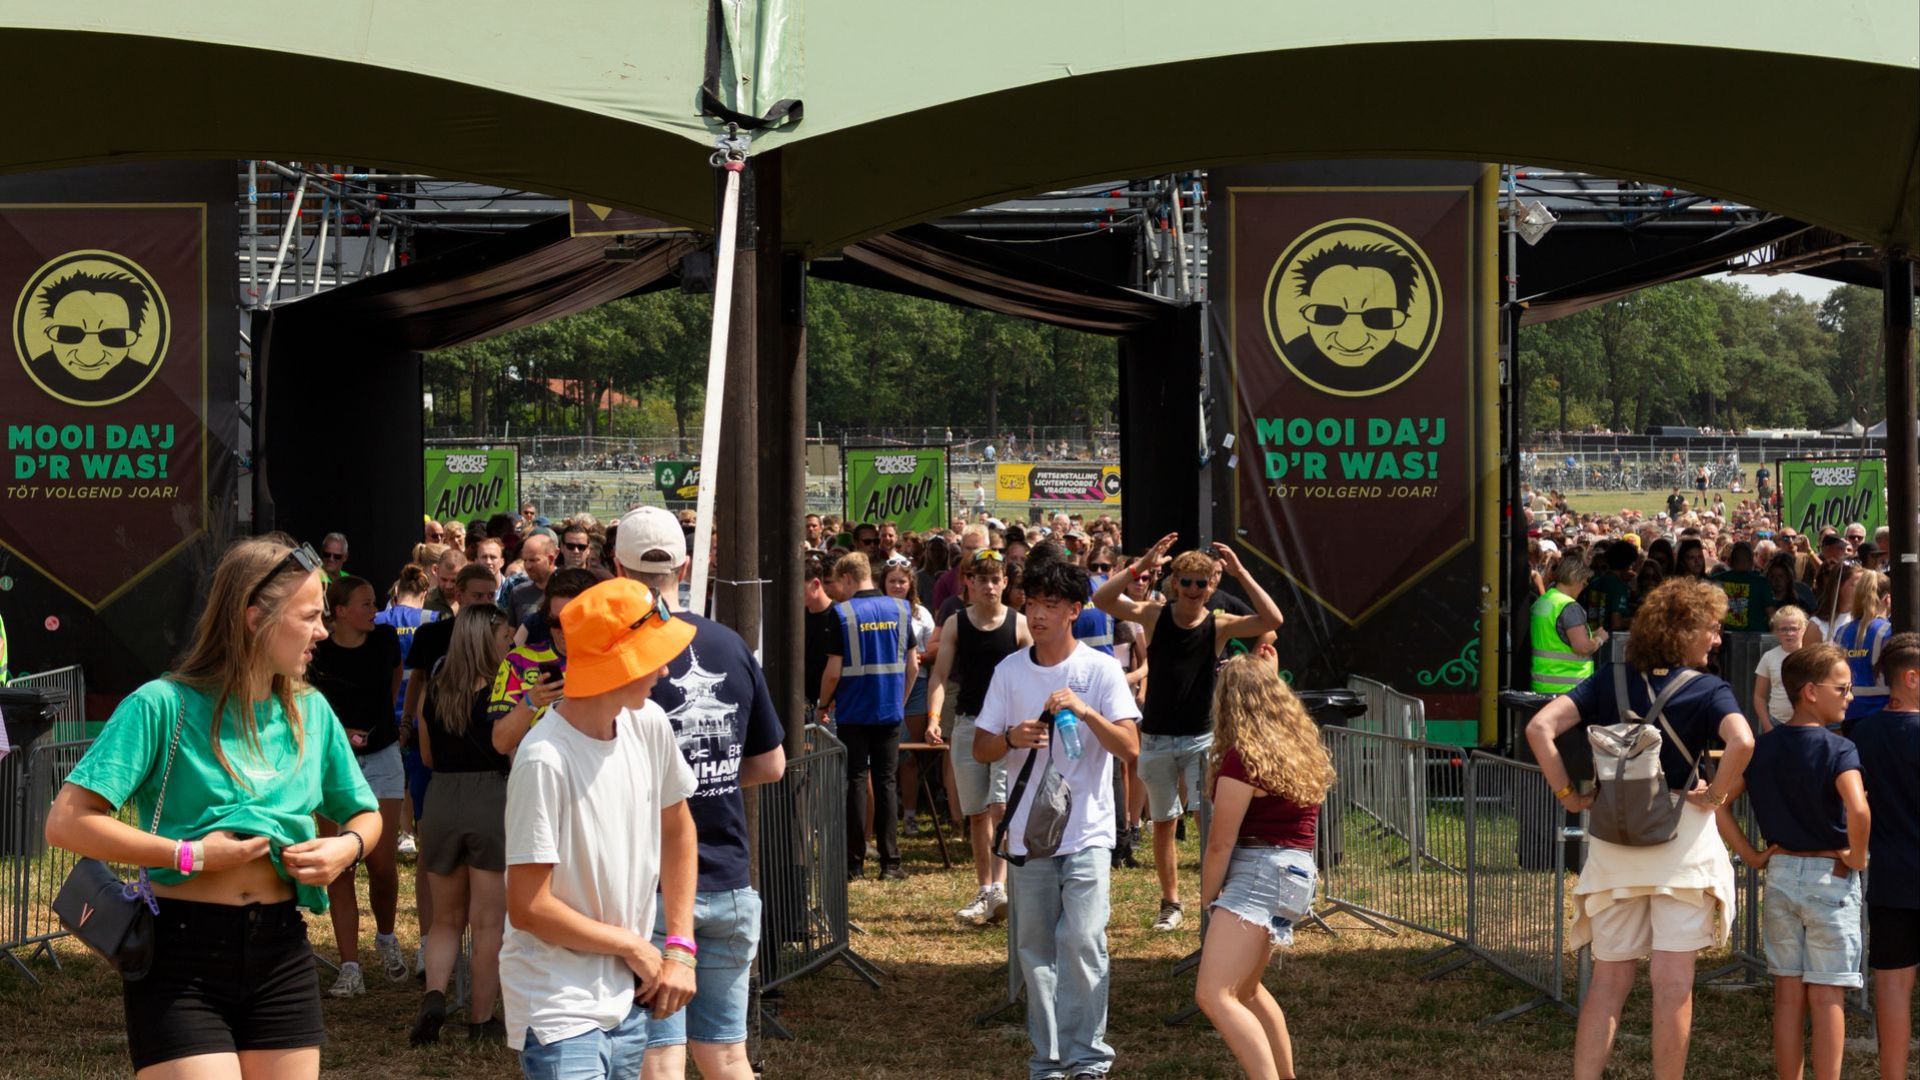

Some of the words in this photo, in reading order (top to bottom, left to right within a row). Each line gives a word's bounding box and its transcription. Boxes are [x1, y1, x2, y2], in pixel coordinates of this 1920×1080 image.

[8, 424, 95, 450] MOOI
[1256, 418, 1355, 446] MOOI
[80, 453, 168, 479] WAS!
[445, 454, 488, 466] ZWARTE
[874, 454, 917, 466] ZWARTE
[1339, 451, 1438, 480] WAS!
[448, 463, 486, 473] CROSS
[878, 463, 915, 474] CROSS
[1811, 466, 1856, 478] ZWARTE
[1037, 472, 1098, 480] FIETSENSTALLING
[1814, 475, 1853, 486] CROSS
[1034, 479, 1093, 487] LICHTENVOORDE
[7, 485, 39, 499] TÖT
[45, 486, 123, 499] VOLGEND
[128, 485, 179, 499] JOAR!
[1044, 486, 1088, 494] VRAGENDER
[1267, 483, 1298, 498] TÖT
[1304, 485, 1382, 498] VOLGEND
[1387, 485, 1438, 498] JOAR!
[434, 476, 503, 520] AJOW!
[862, 475, 933, 521] AJOW!
[1799, 488, 1873, 533] AJOW!
[860, 621, 898, 632] SECURITY
